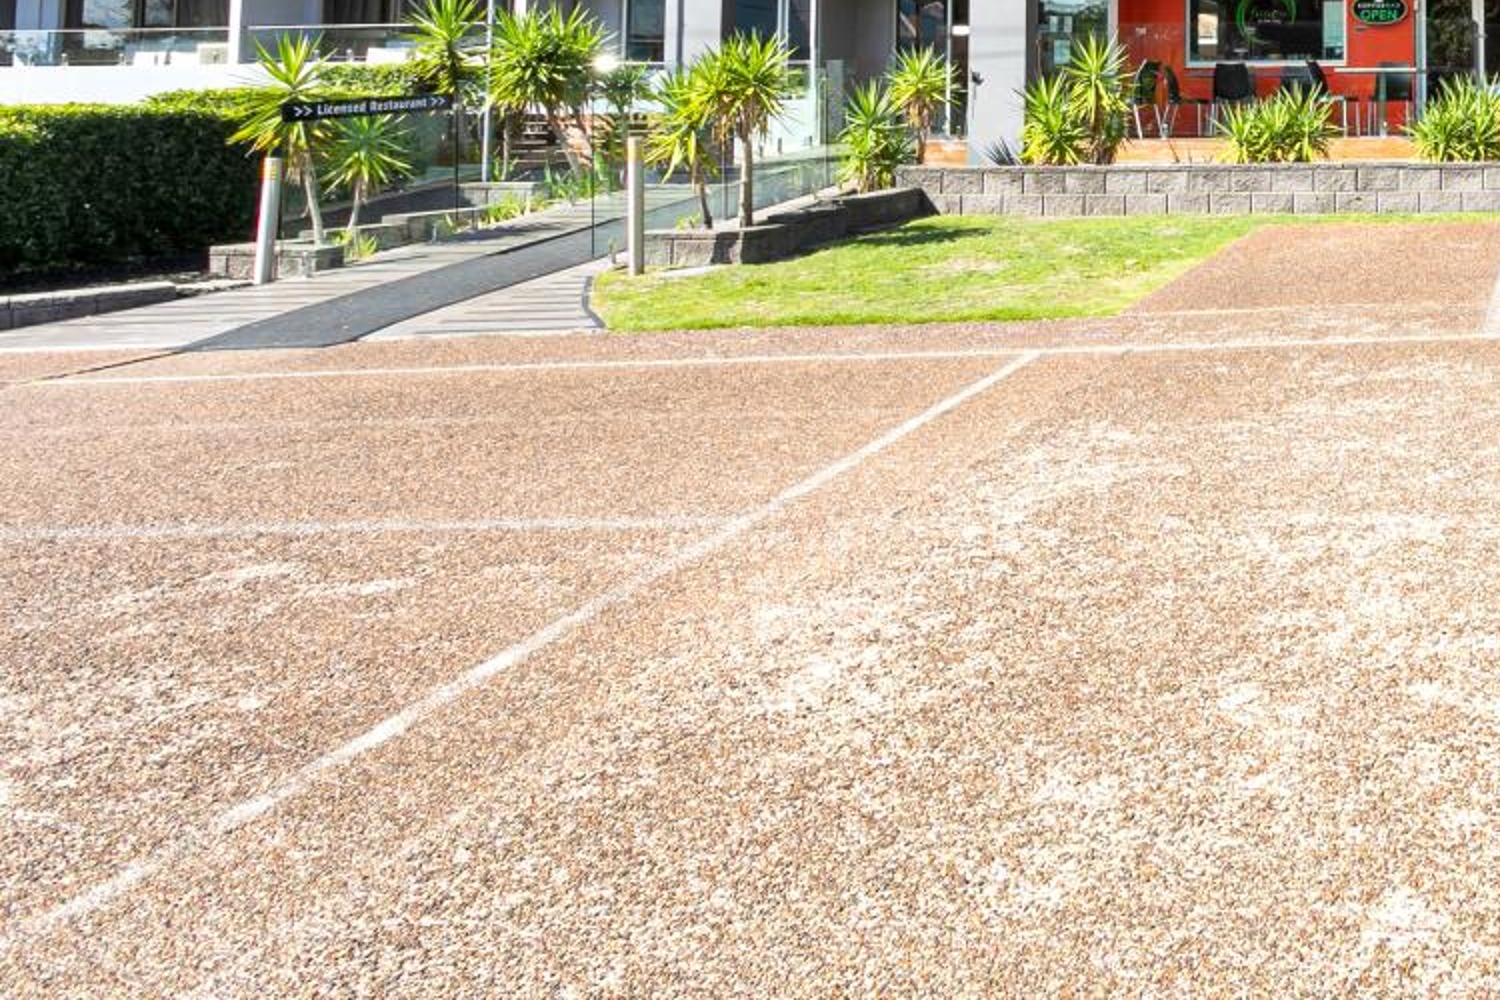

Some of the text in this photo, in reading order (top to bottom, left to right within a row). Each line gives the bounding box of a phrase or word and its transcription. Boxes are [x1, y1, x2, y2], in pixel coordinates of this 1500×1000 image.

[1360, 9, 1397, 20] OPEN
[317, 97, 427, 116] Licensed Restaurant
